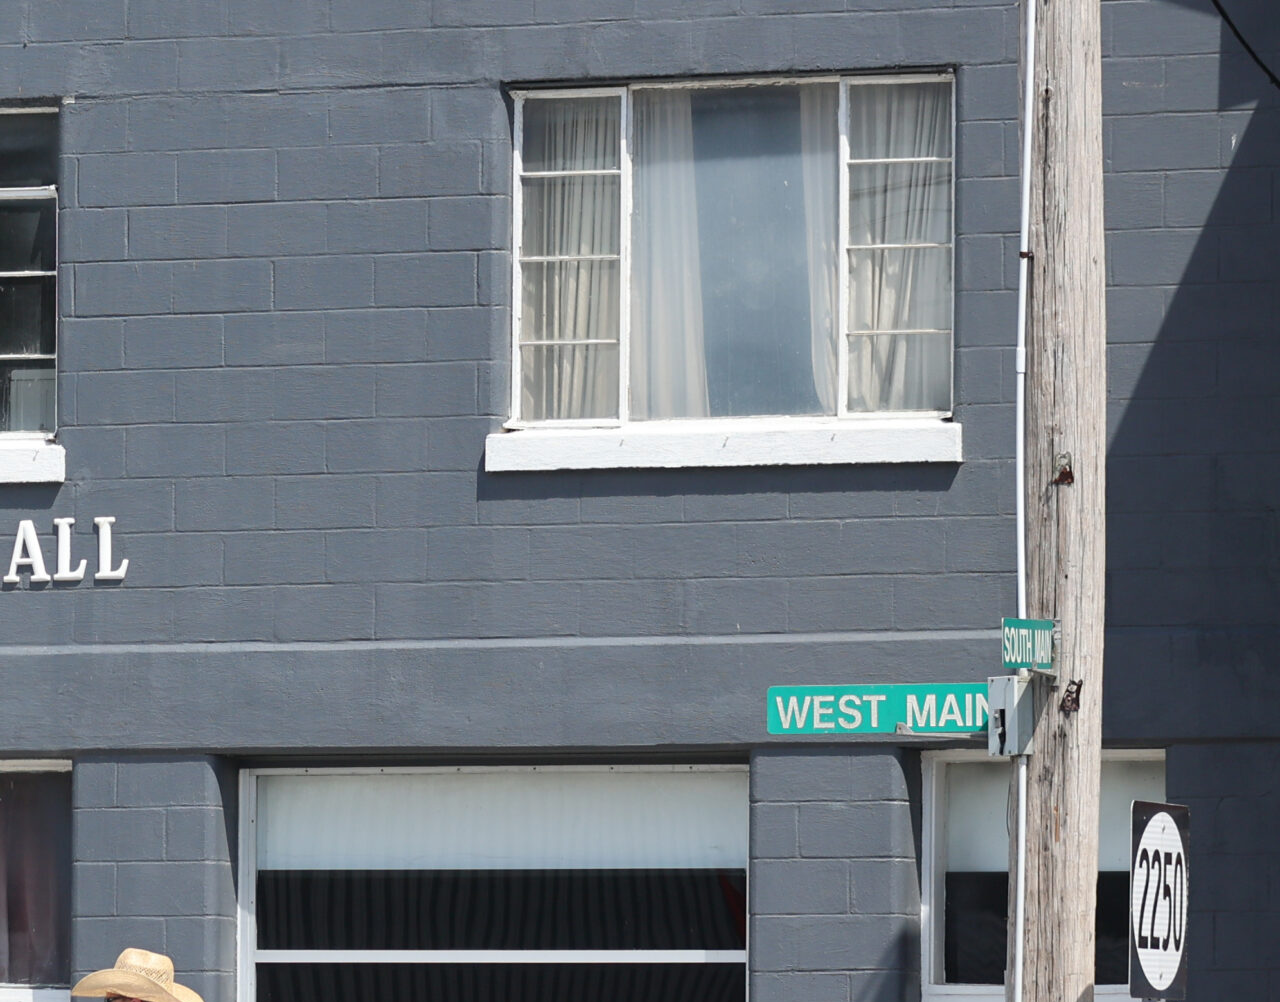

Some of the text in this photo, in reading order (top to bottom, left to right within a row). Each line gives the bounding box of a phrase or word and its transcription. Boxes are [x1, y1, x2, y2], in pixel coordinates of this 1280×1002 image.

[1004, 626, 1052, 663] SOUTH MAIN
[775, 693, 887, 730] WEST
[1138, 848, 1183, 953] 2250
